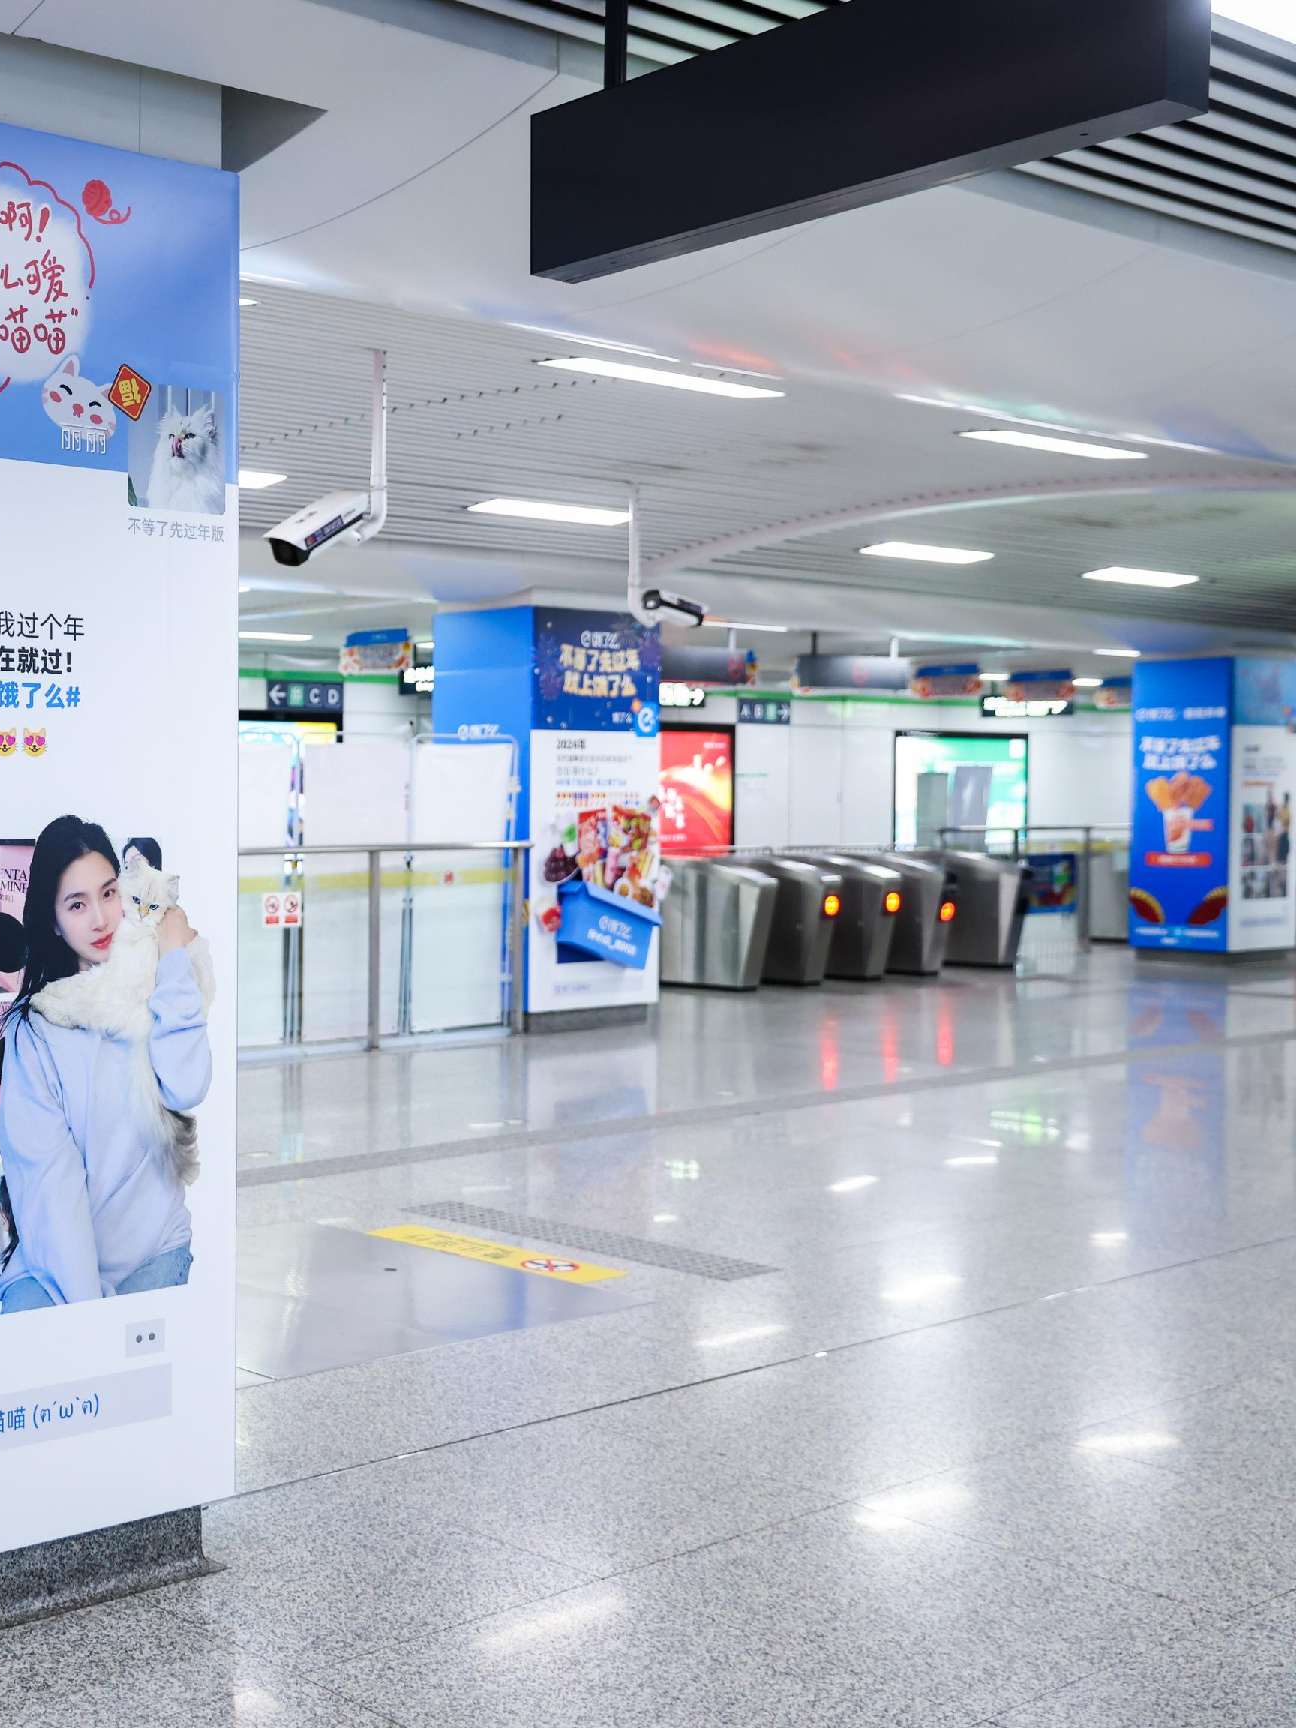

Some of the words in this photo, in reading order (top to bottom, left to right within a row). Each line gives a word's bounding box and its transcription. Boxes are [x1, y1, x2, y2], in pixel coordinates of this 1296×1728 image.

[128, 517, 224, 542] 不等了先过年版
